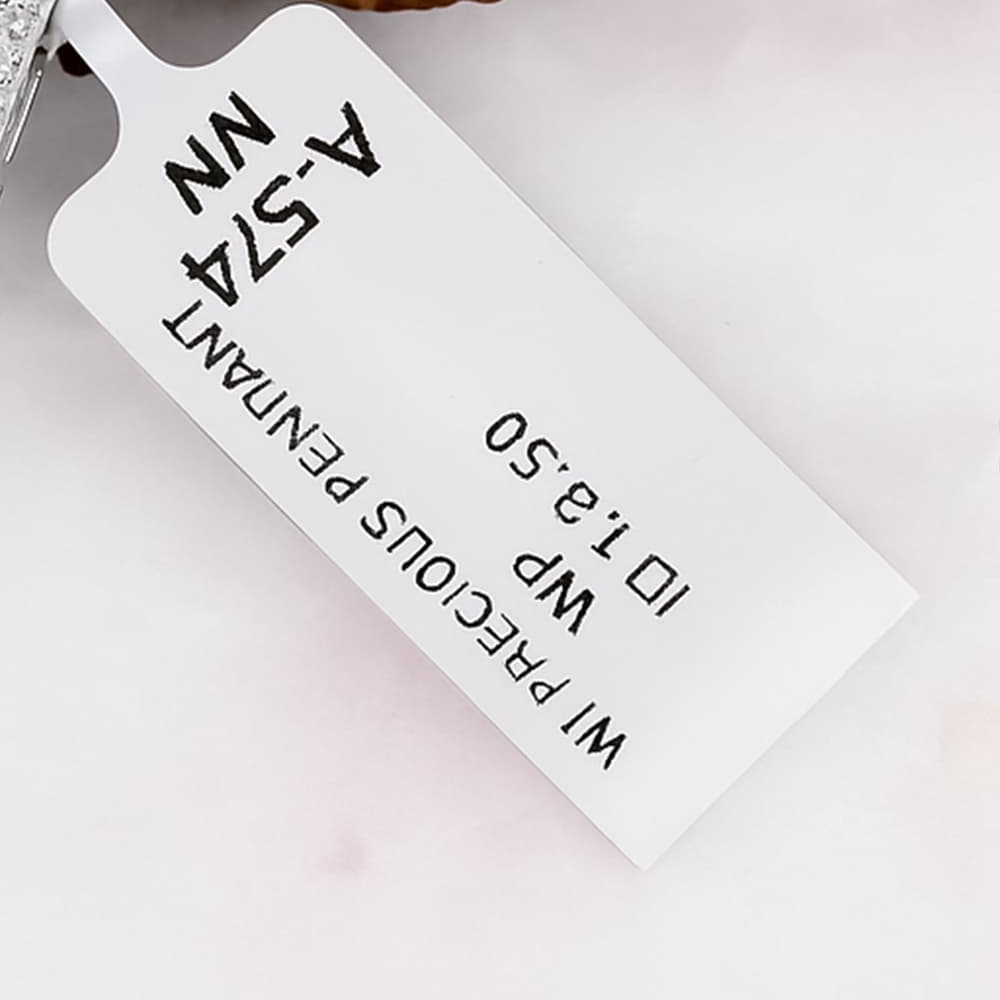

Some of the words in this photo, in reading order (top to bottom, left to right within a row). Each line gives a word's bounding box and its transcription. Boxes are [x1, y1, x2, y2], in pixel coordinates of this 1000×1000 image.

[162, 89, 278, 217] NN
[178, 100, 382, 308] A-574
[359, 500, 572, 707] PRECIOUS
[511, 552, 597, 636] WP
